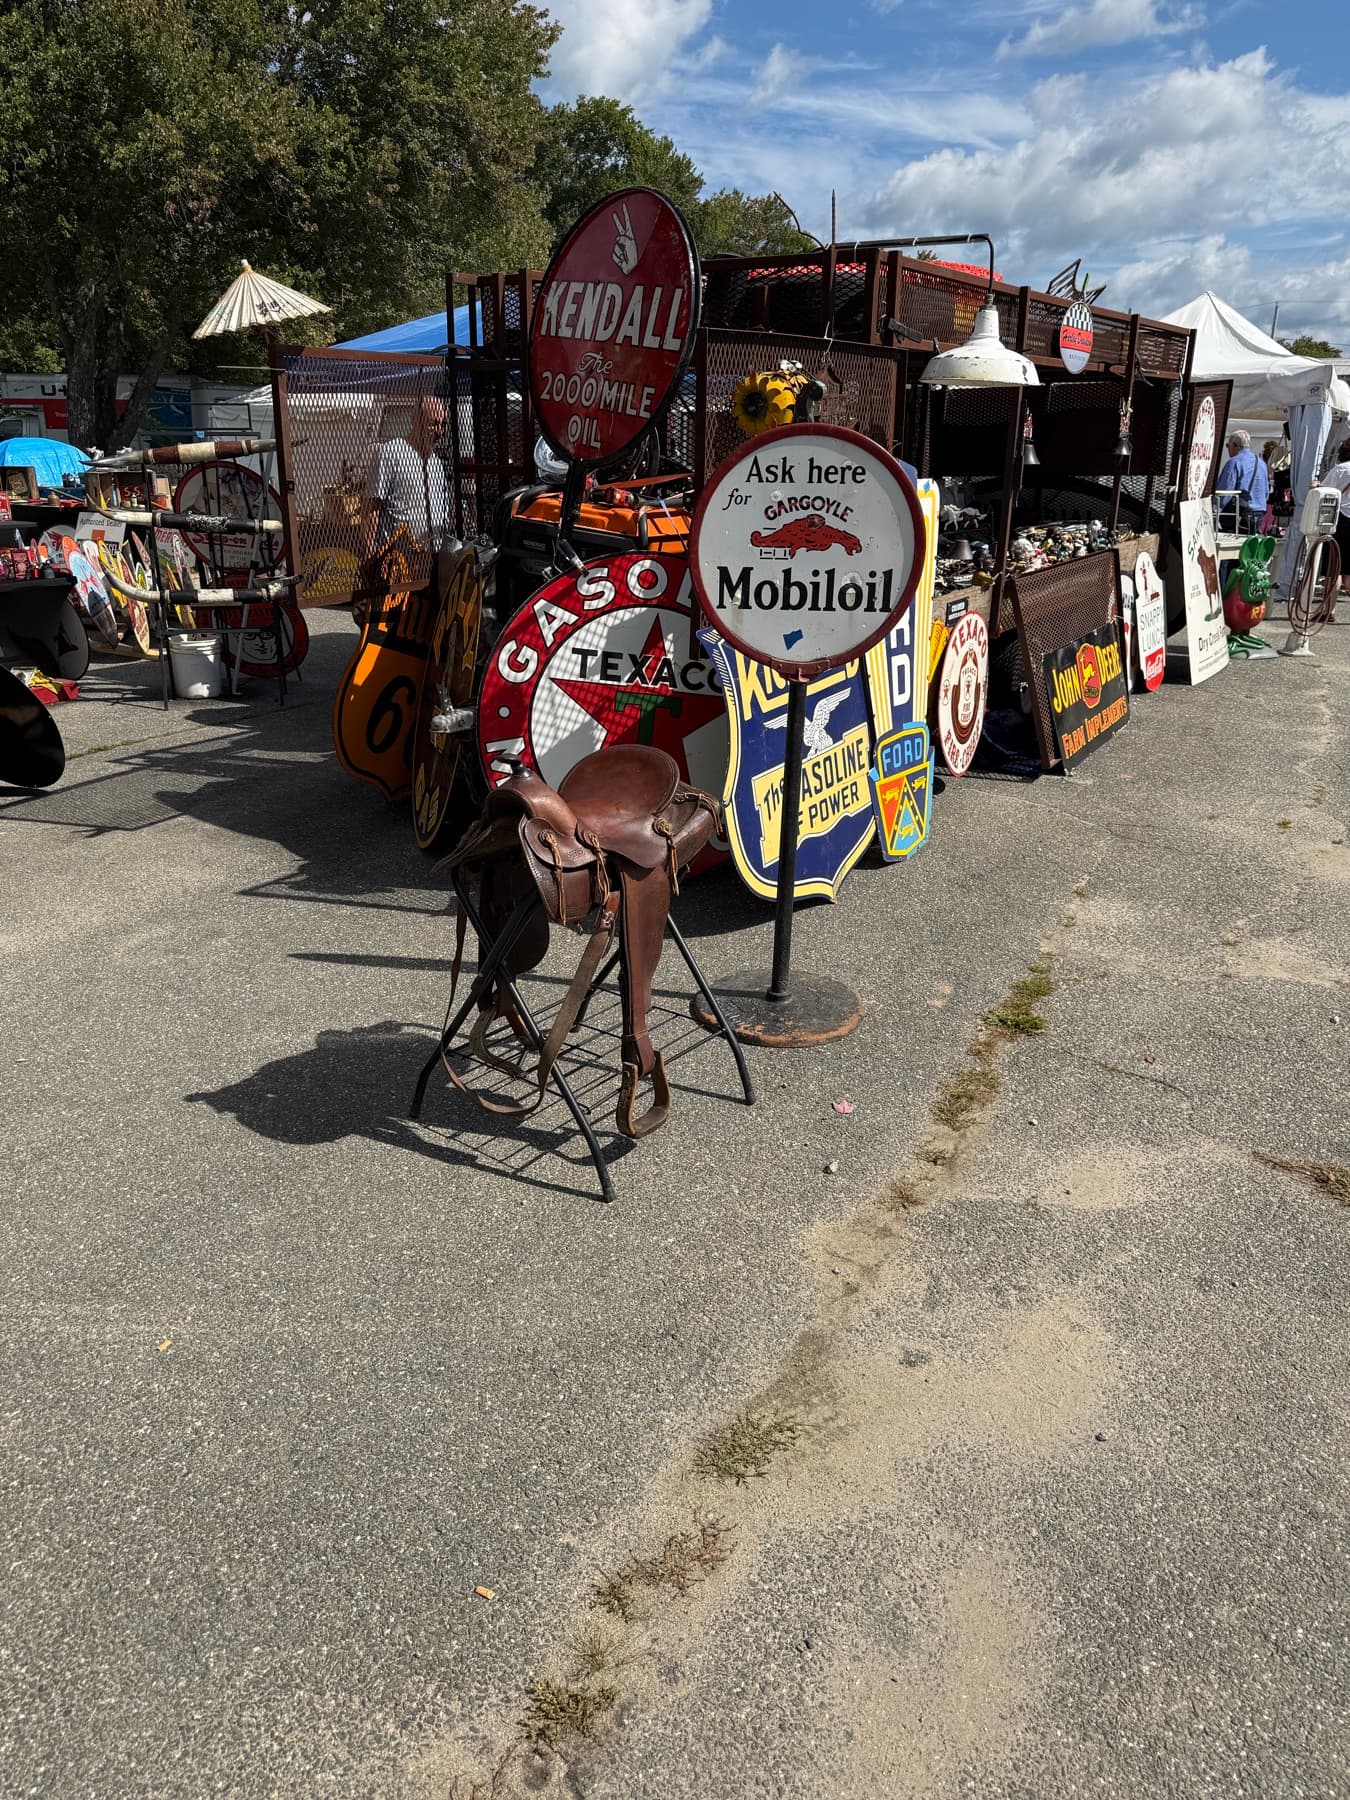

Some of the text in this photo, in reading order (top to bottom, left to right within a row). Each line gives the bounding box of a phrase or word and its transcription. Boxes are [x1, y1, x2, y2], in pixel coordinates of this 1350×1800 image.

[541, 280, 685, 352] KENDALL
[578, 352, 613, 374] The
[540, 371, 656, 420] 2000 MILE
[568, 414, 602, 449] OIL
[745, 456, 867, 484] Ask here
[722, 488, 752, 511] for
[764, 495, 854, 523] GARGOYLE
[716, 566, 894, 613] Mobiloil
[951, 618, 987, 658] TEXACO
[1053, 641, 1122, 713] JOHN DEERE
[1062, 695, 1129, 759] FARM IMPLEMENTS
[801, 738, 865, 802] ASOLINE
[882, 737, 923, 773] FORD
[808, 781, 860, 830] POWER
